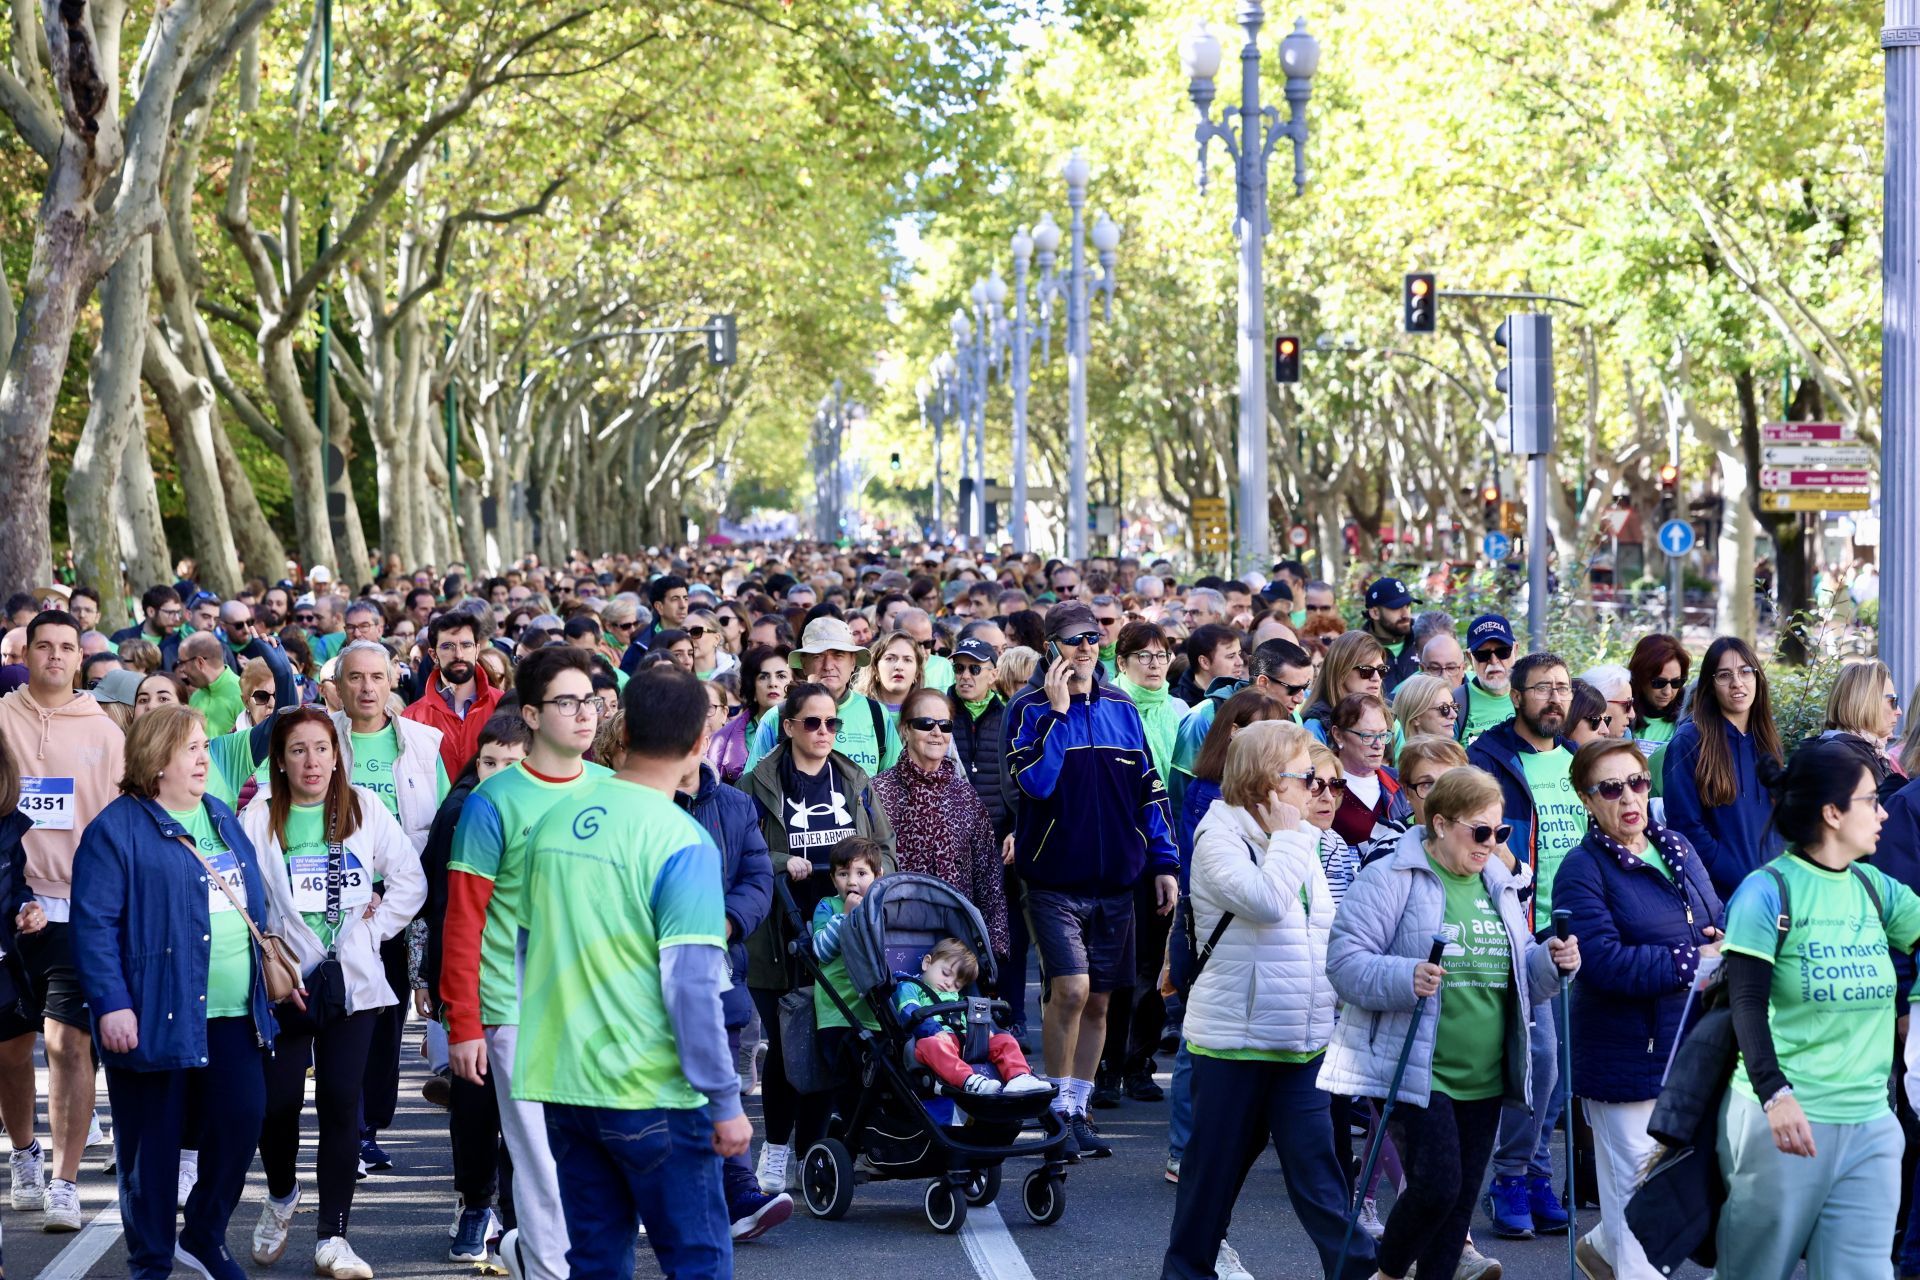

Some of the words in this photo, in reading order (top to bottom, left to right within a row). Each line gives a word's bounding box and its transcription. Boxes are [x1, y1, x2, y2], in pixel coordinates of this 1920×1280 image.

[1473, 621, 1506, 635] VENEZIA
[848, 751, 877, 764] rcha
[20, 796, 64, 811] 4351
[1538, 804, 1548, 815] n
[1551, 803, 1585, 816] marc
[1538, 818, 1576, 832] ontra
[790, 831, 822, 847] UNDER
[1552, 833, 1581, 849] cánc
[330, 858, 341, 889] LOLA
[1471, 919, 1507, 935] aec
[1472, 946, 1486, 956] en
[1488, 948, 1510, 957] mar
[1809, 942, 1836, 958] En
[1443, 960, 1471, 968] Marcha
[1472, 960, 1493, 969] Contra
[1494, 961, 1500, 969] el
[1812, 964, 1878, 980] contra
[1814, 984, 1836, 1002] el
